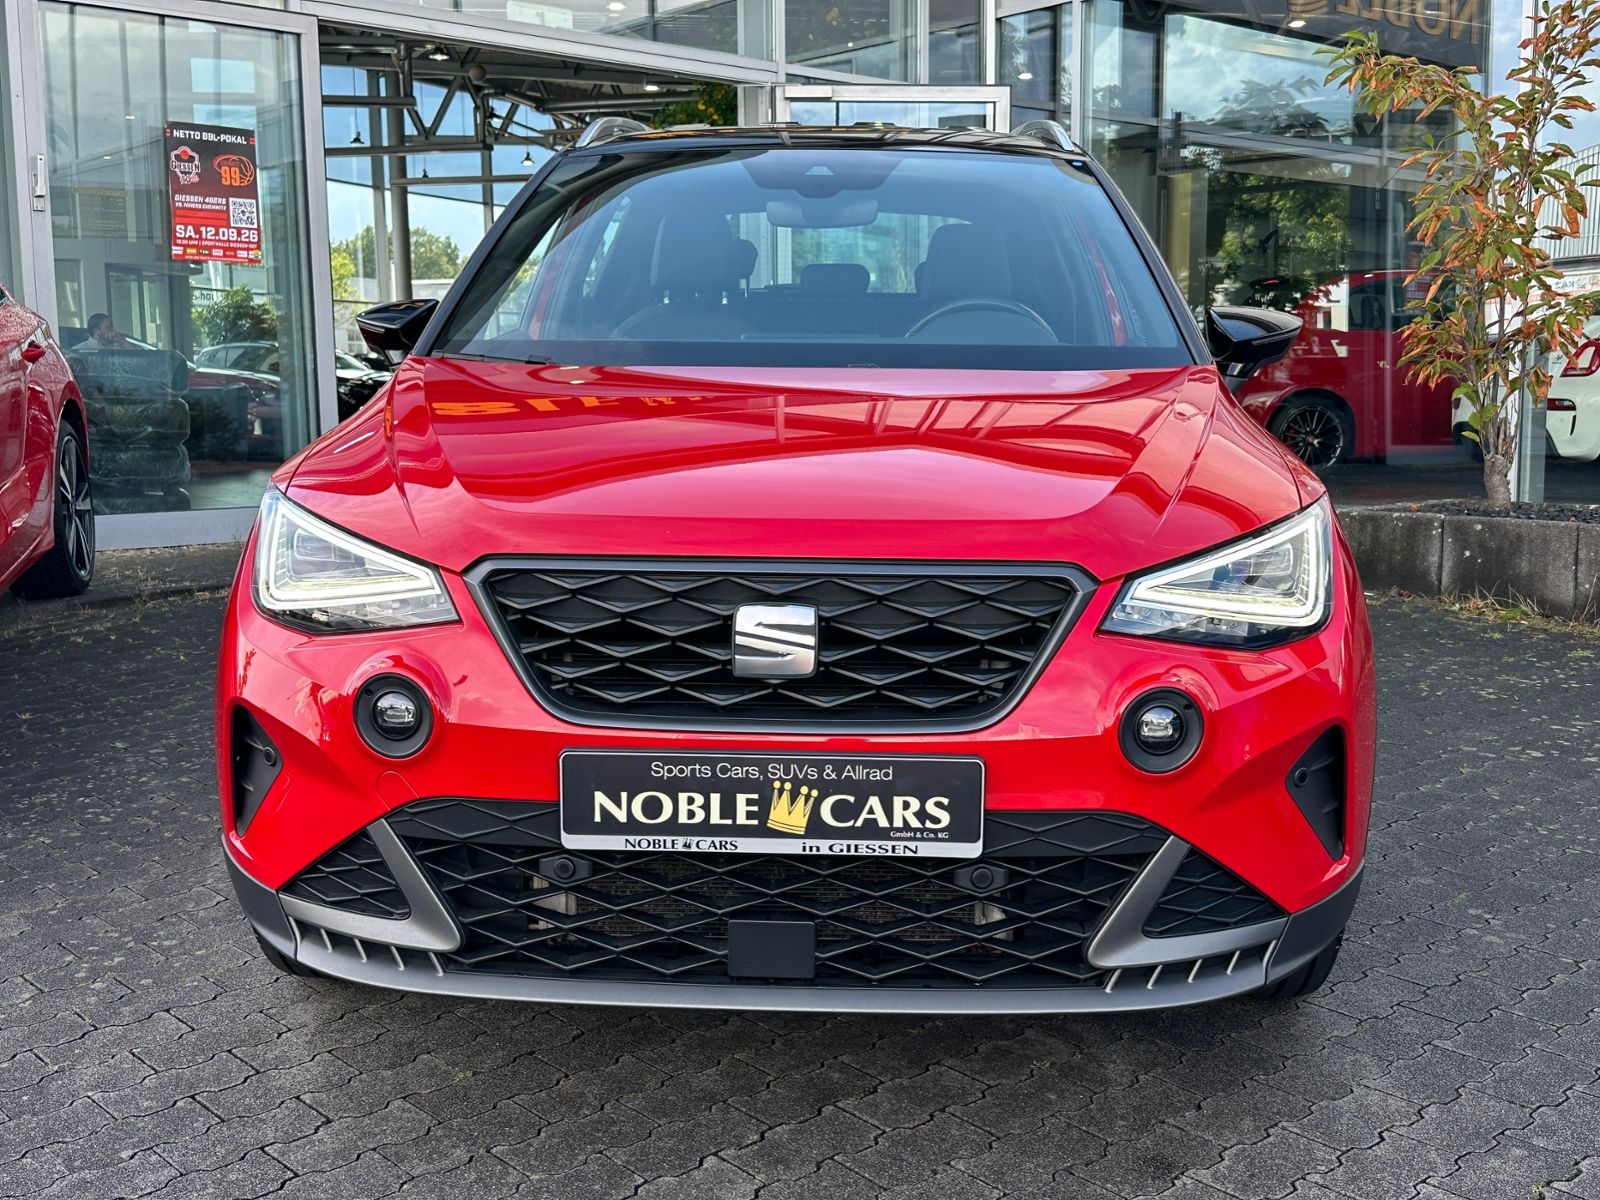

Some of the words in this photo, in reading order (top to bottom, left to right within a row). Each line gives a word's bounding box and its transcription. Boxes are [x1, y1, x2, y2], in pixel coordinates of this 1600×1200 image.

[173, 129, 200, 139] NETTO
[203, 132, 247, 144] BBL-POKAL
[221, 166, 240, 186] 99
[175, 194, 203, 203] GIESSEN
[651, 762, 712, 779] Sports
[716, 762, 763, 780] Cars,
[768, 764, 817, 780] SUVs
[823, 765, 837, 780] &
[841, 765, 892, 780] Allrad
[594, 791, 759, 825] NOBLE
[820, 794, 951, 829] CARS
[624, 838, 679, 850] NOBLE
[696, 839, 738, 851] CARS
[802, 842, 820, 853] in
[828, 843, 918, 855] GIESSEN
